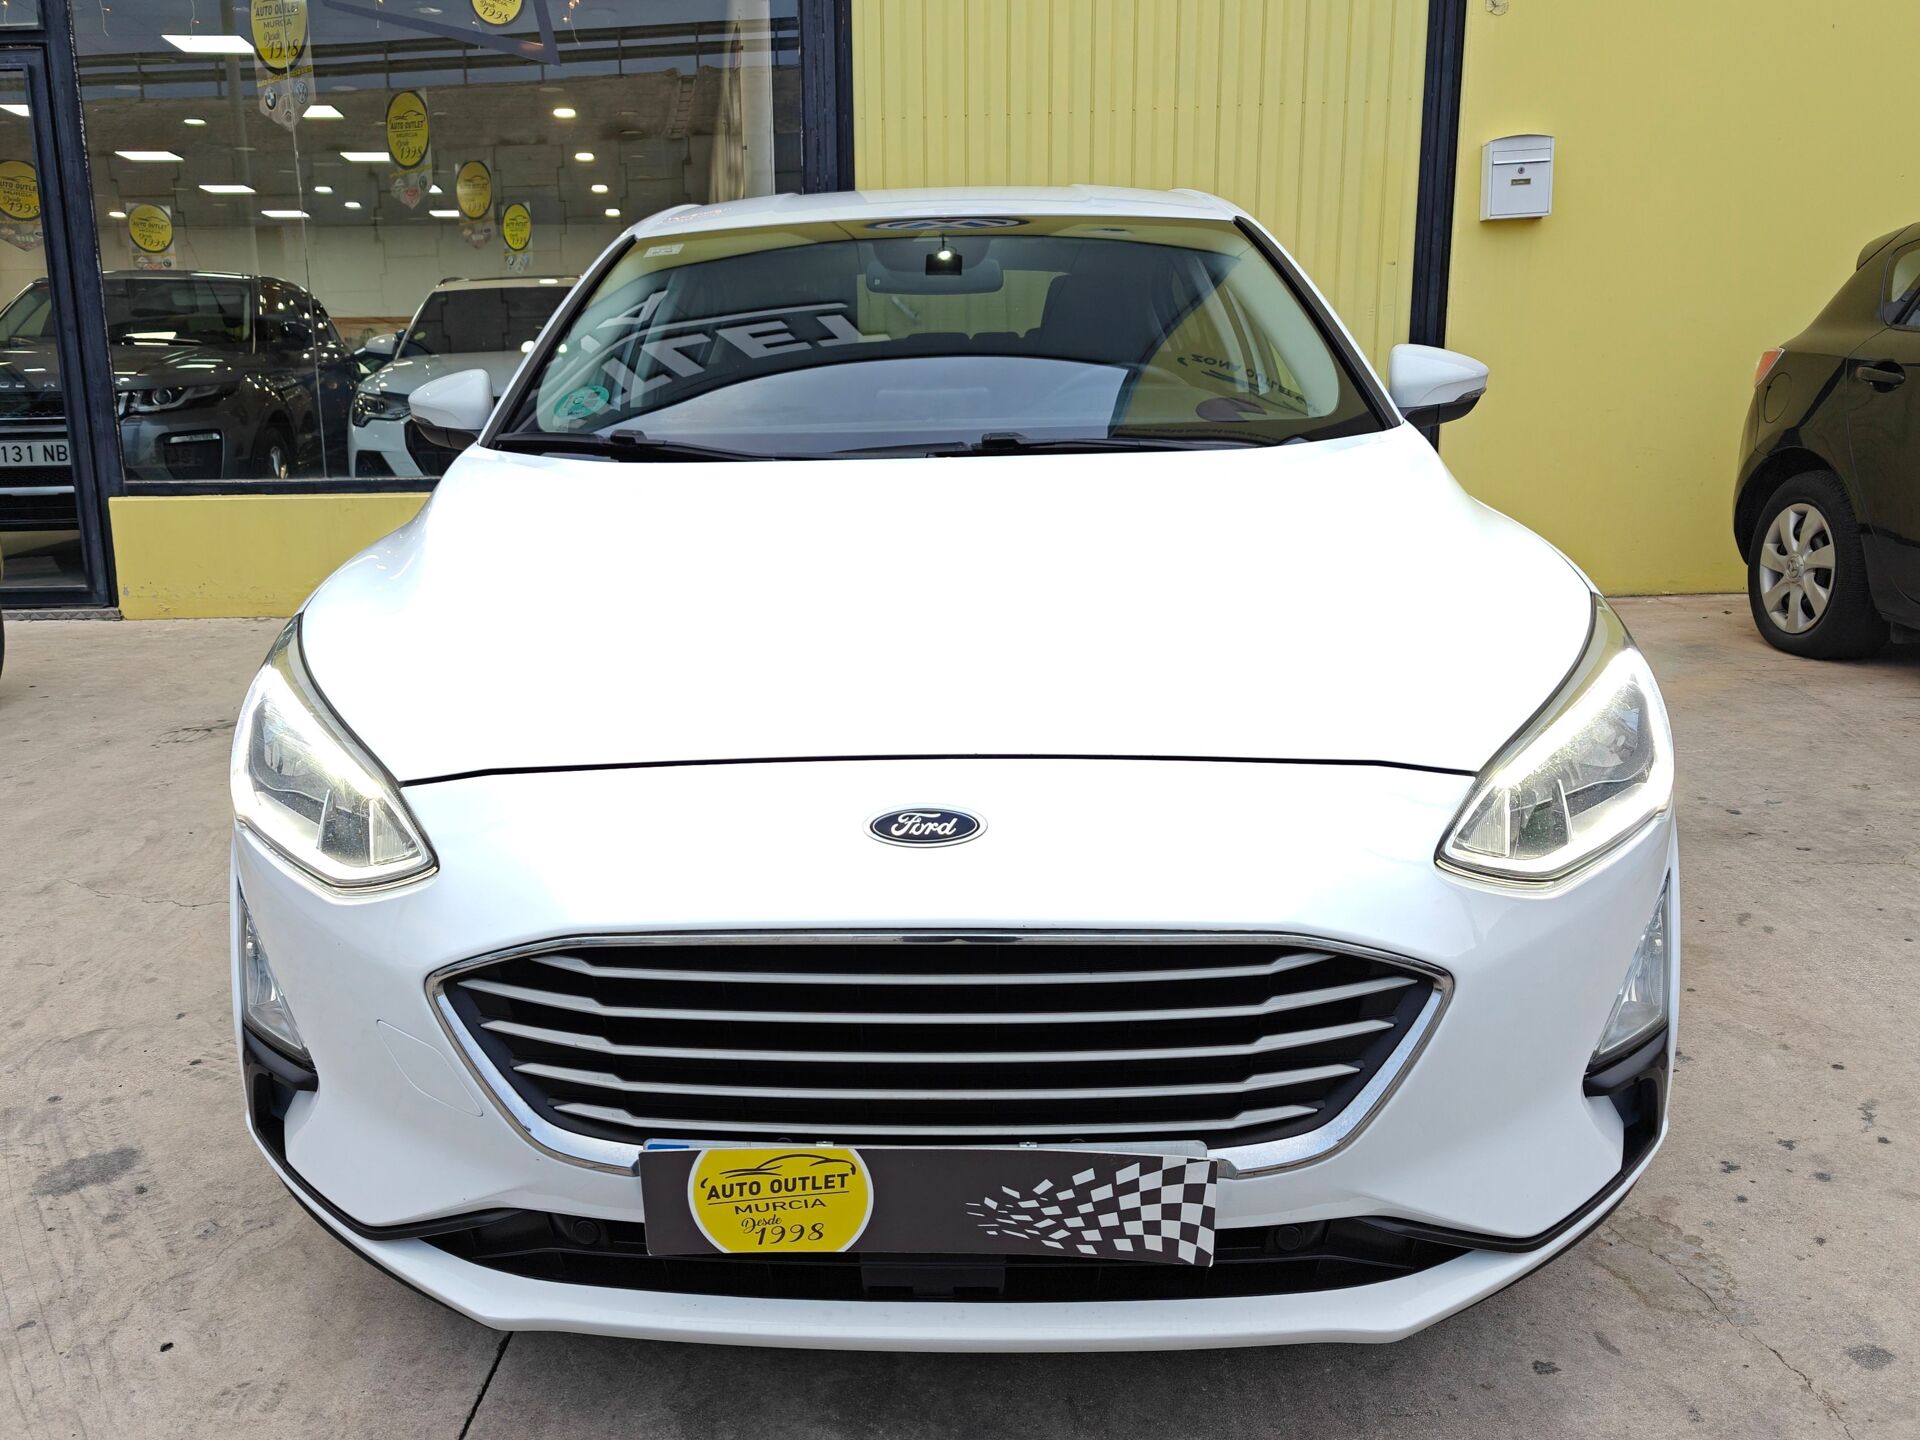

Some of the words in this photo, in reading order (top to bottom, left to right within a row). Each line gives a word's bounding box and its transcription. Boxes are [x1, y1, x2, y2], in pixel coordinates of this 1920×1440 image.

[890, 812, 958, 837] Ford
[706, 1180, 761, 1200] AUTO
[769, 1173, 850, 1194] OUTLET
[734, 1198, 827, 1215] MURCIA
[741, 1214, 783, 1235] Desde
[754, 1222, 824, 1246] 1998
